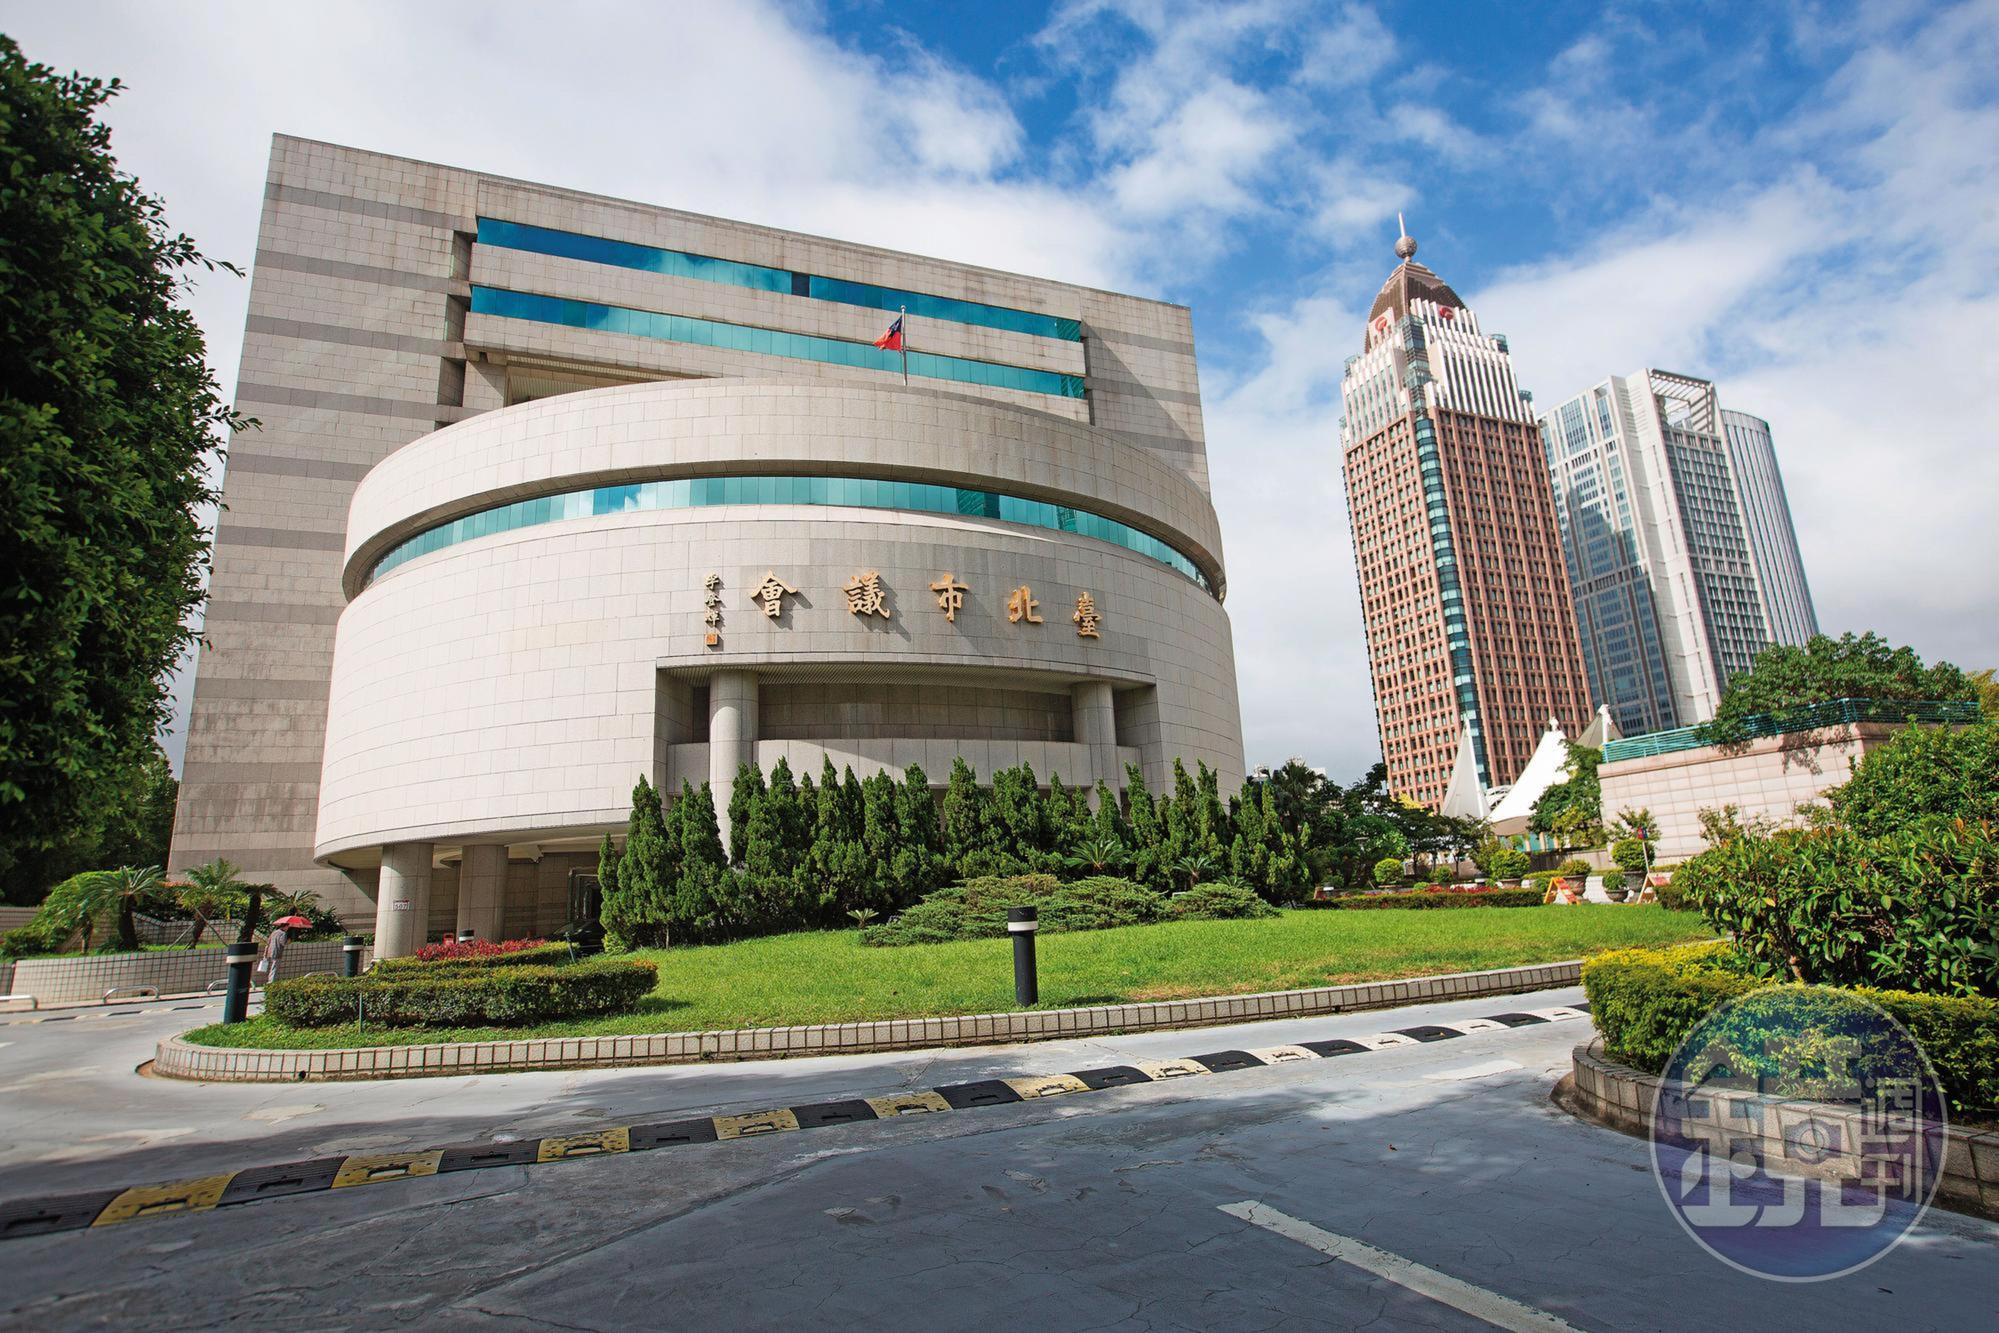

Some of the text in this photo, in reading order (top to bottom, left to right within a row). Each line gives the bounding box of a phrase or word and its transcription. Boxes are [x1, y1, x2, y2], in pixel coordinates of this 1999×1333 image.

[751, 569, 1102, 638] 臺北市議會
